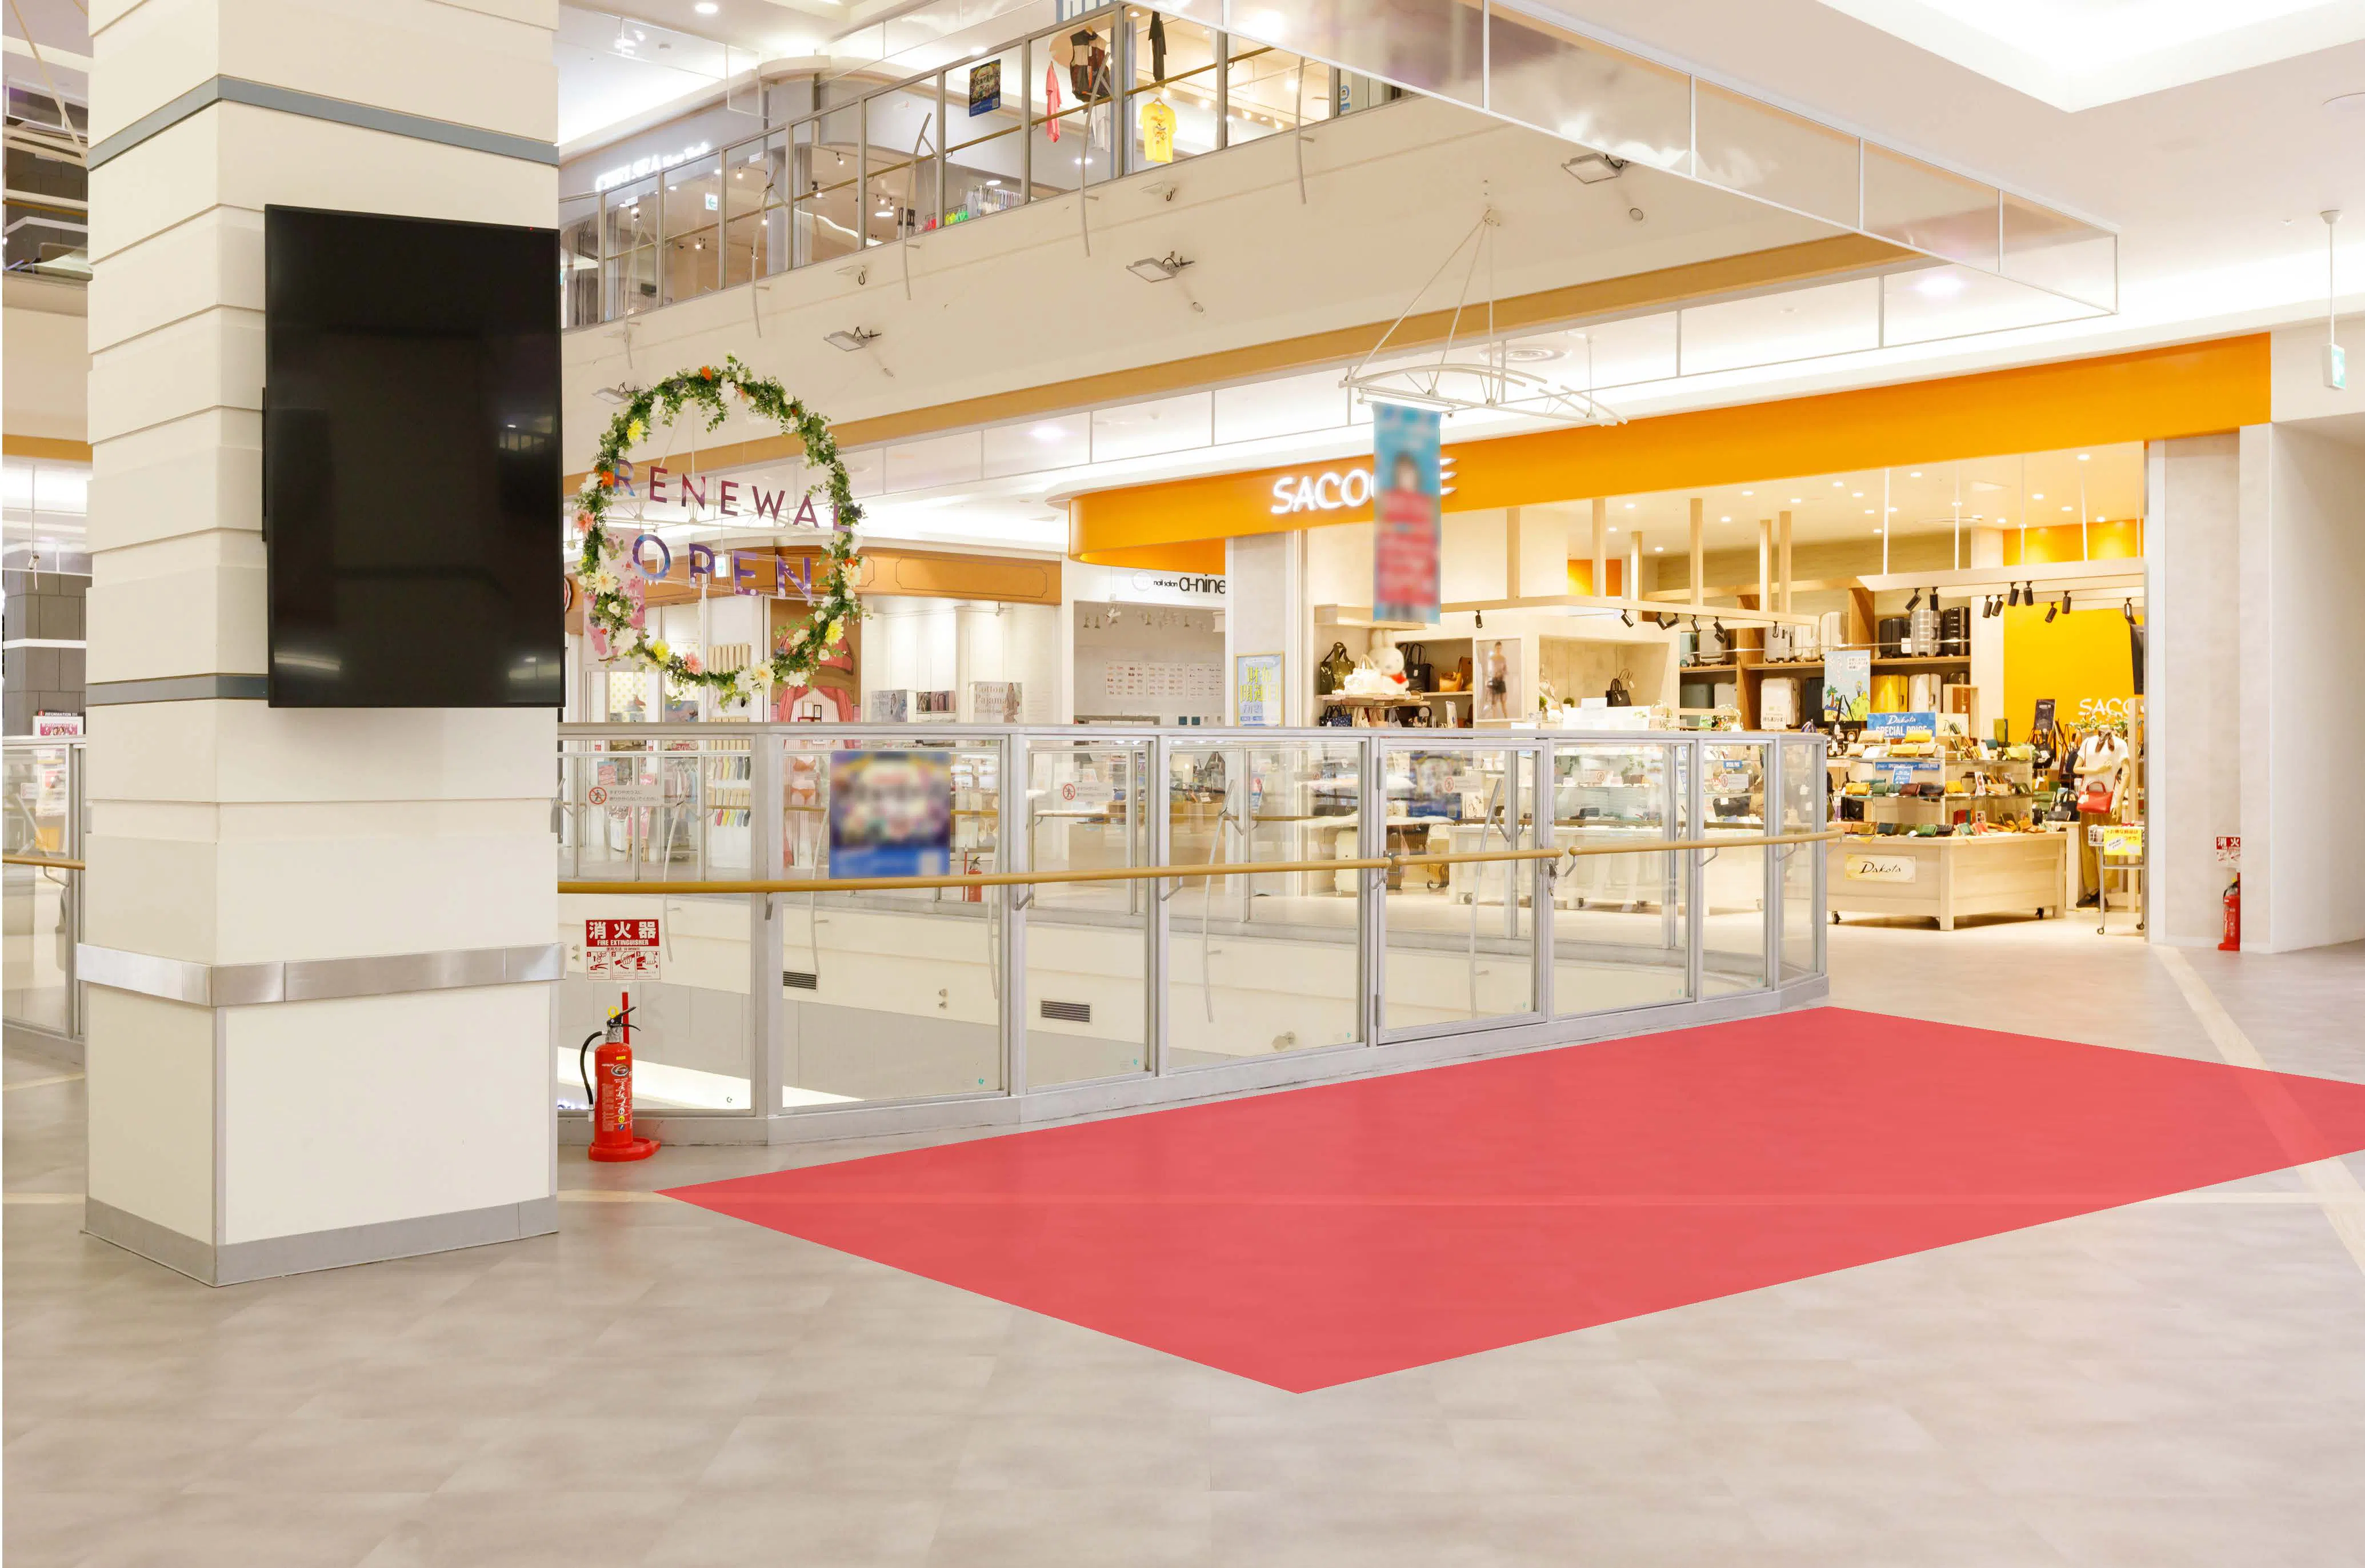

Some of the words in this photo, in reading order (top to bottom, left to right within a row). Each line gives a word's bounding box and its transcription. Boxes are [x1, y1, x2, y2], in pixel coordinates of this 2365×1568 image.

[1270, 456, 1458, 514] SACOE
[613, 459, 851, 532] RENEWAL
[632, 534, 813, 607] OPEN
[1179, 574, 1226, 594] a-nine
[1887, 715, 1916, 725] Dakota
[1859, 861, 1902, 874] Dakota
[589, 921, 656, 939] 消火器
